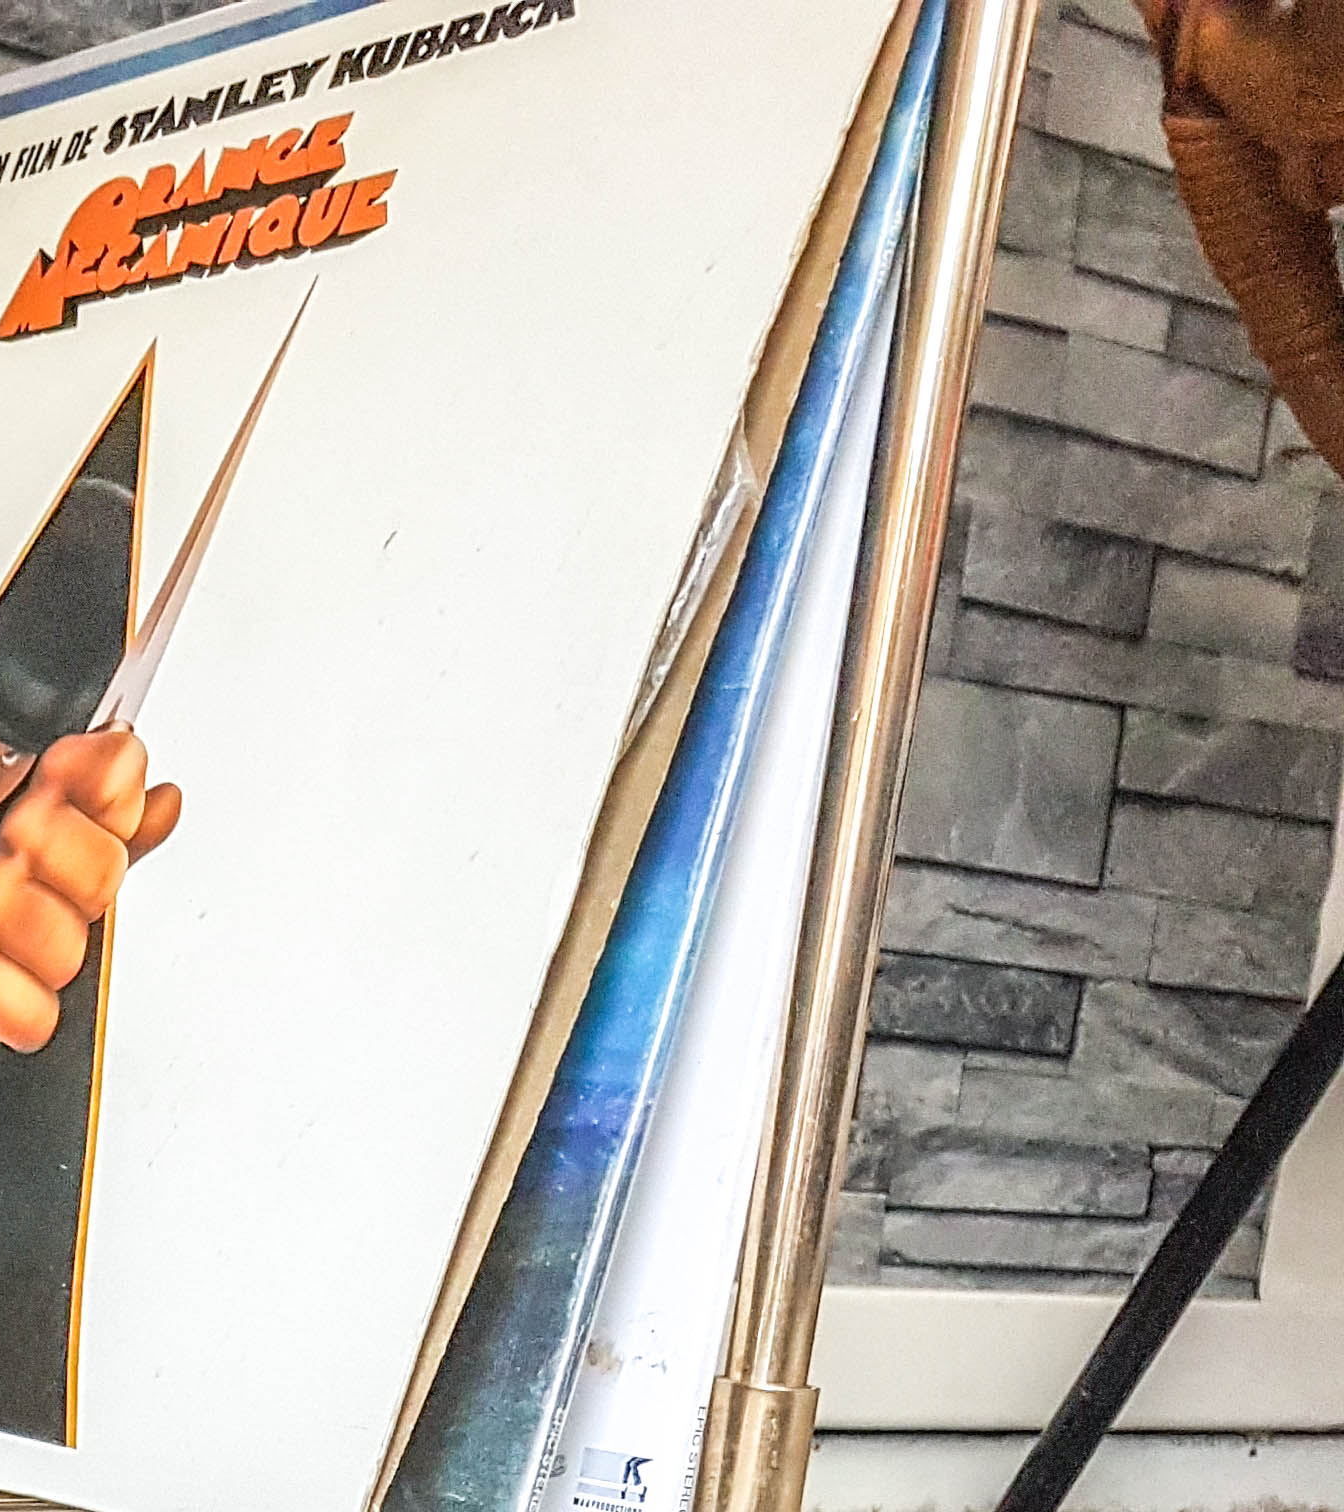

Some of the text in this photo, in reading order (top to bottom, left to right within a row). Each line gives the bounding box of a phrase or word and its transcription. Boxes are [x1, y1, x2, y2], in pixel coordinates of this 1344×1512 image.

[9, 136, 64, 183] FILM
[62, 125, 99, 167] DE
[101, 55, 330, 155] STANLEY
[327, 0, 575, 89] KUBRICK
[55, 112, 355, 262] ORANGE
[690, 1405, 707, 1447] EPIC
